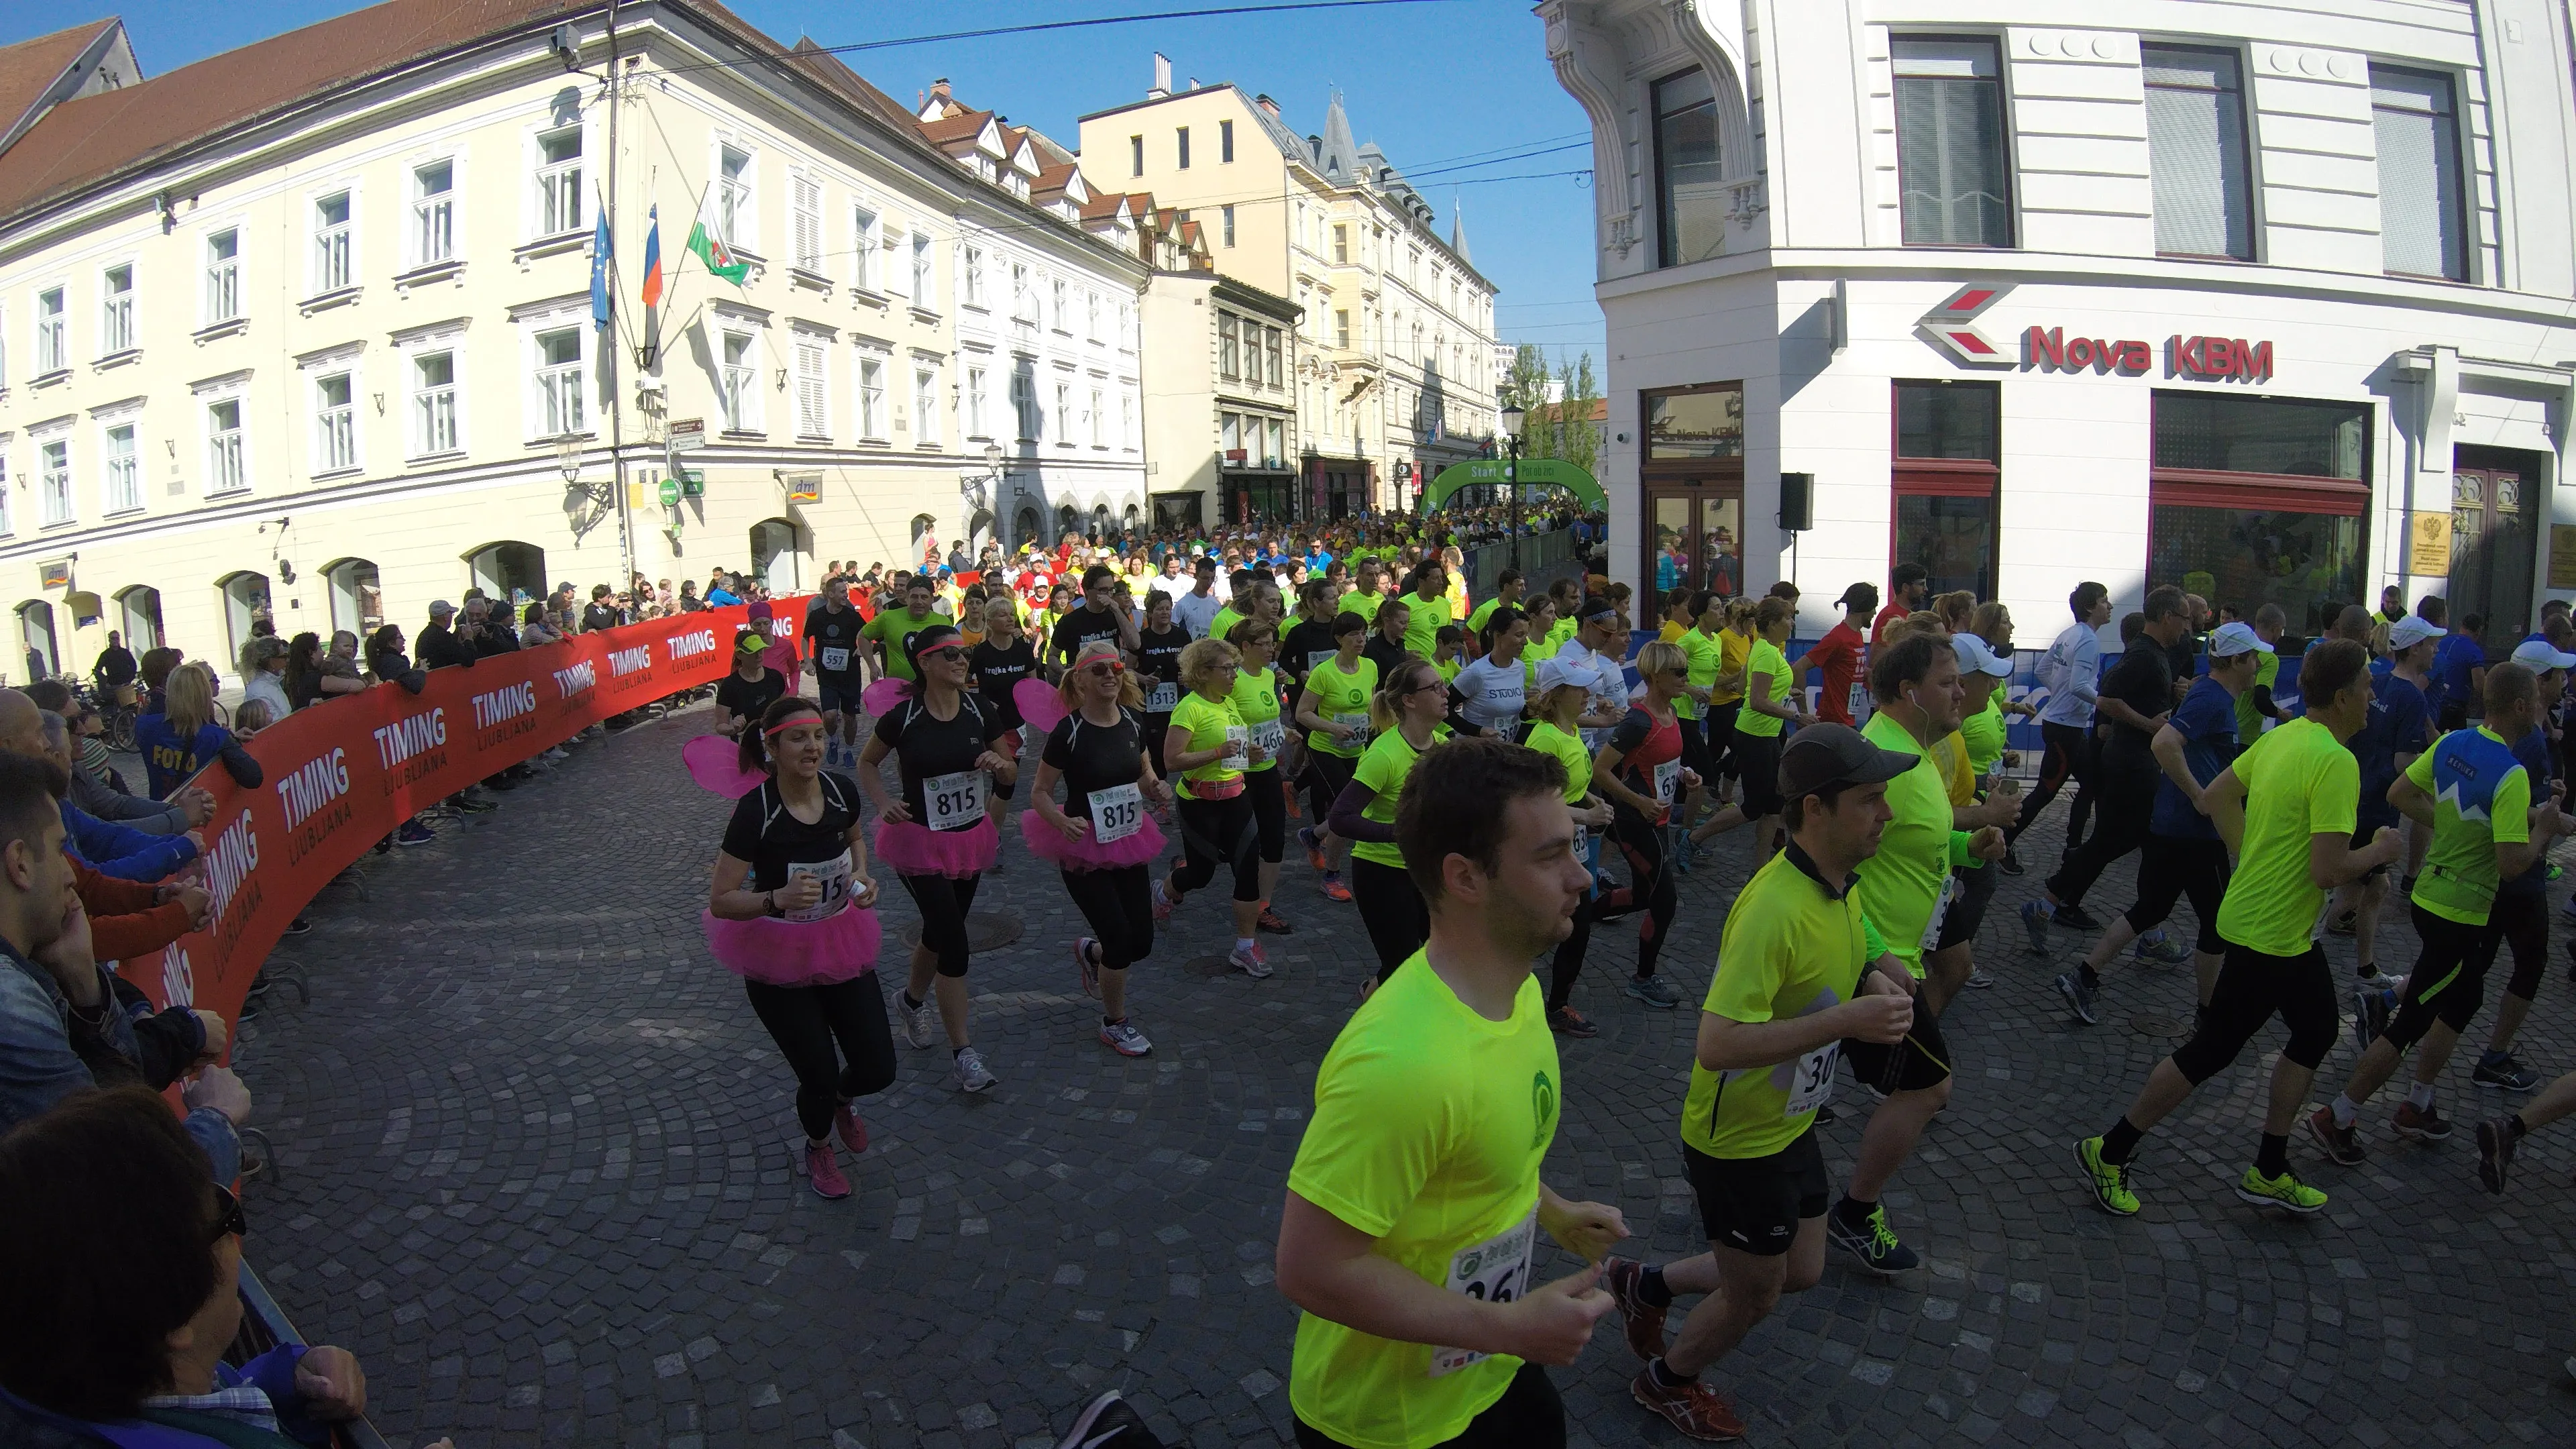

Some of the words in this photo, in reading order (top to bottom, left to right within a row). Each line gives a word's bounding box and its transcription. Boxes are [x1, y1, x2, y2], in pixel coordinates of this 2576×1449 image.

[2030, 326, 2151, 368] Nova
[2173, 335, 2273, 378] KBM
[796, 479, 815, 493] dm
[1471, 466, 1497, 478] Start
[48, 567, 64, 579] dm
[667, 630, 715, 660] TIMING
[826, 655, 844, 665] 557
[608, 645, 651, 678] TIMING
[672, 655, 717, 675] LJUBLJANA
[553, 659, 596, 700] TIMING
[613, 672, 653, 694] LJUBLJANA
[472, 680, 536, 730] TIMING
[1148, 692, 1176, 705] 1313
[374, 707, 446, 771] TIMING
[477, 717, 537, 752] LJUBLJANA
[1254, 730, 1284, 751] 1466
[384, 751, 447, 797] LJUBLJANA
[278, 747, 350, 834] TIMING
[936, 786, 975, 816] 815
[1103, 802, 1136, 828] 815
[288, 802, 352, 868] LJUBLJANA
